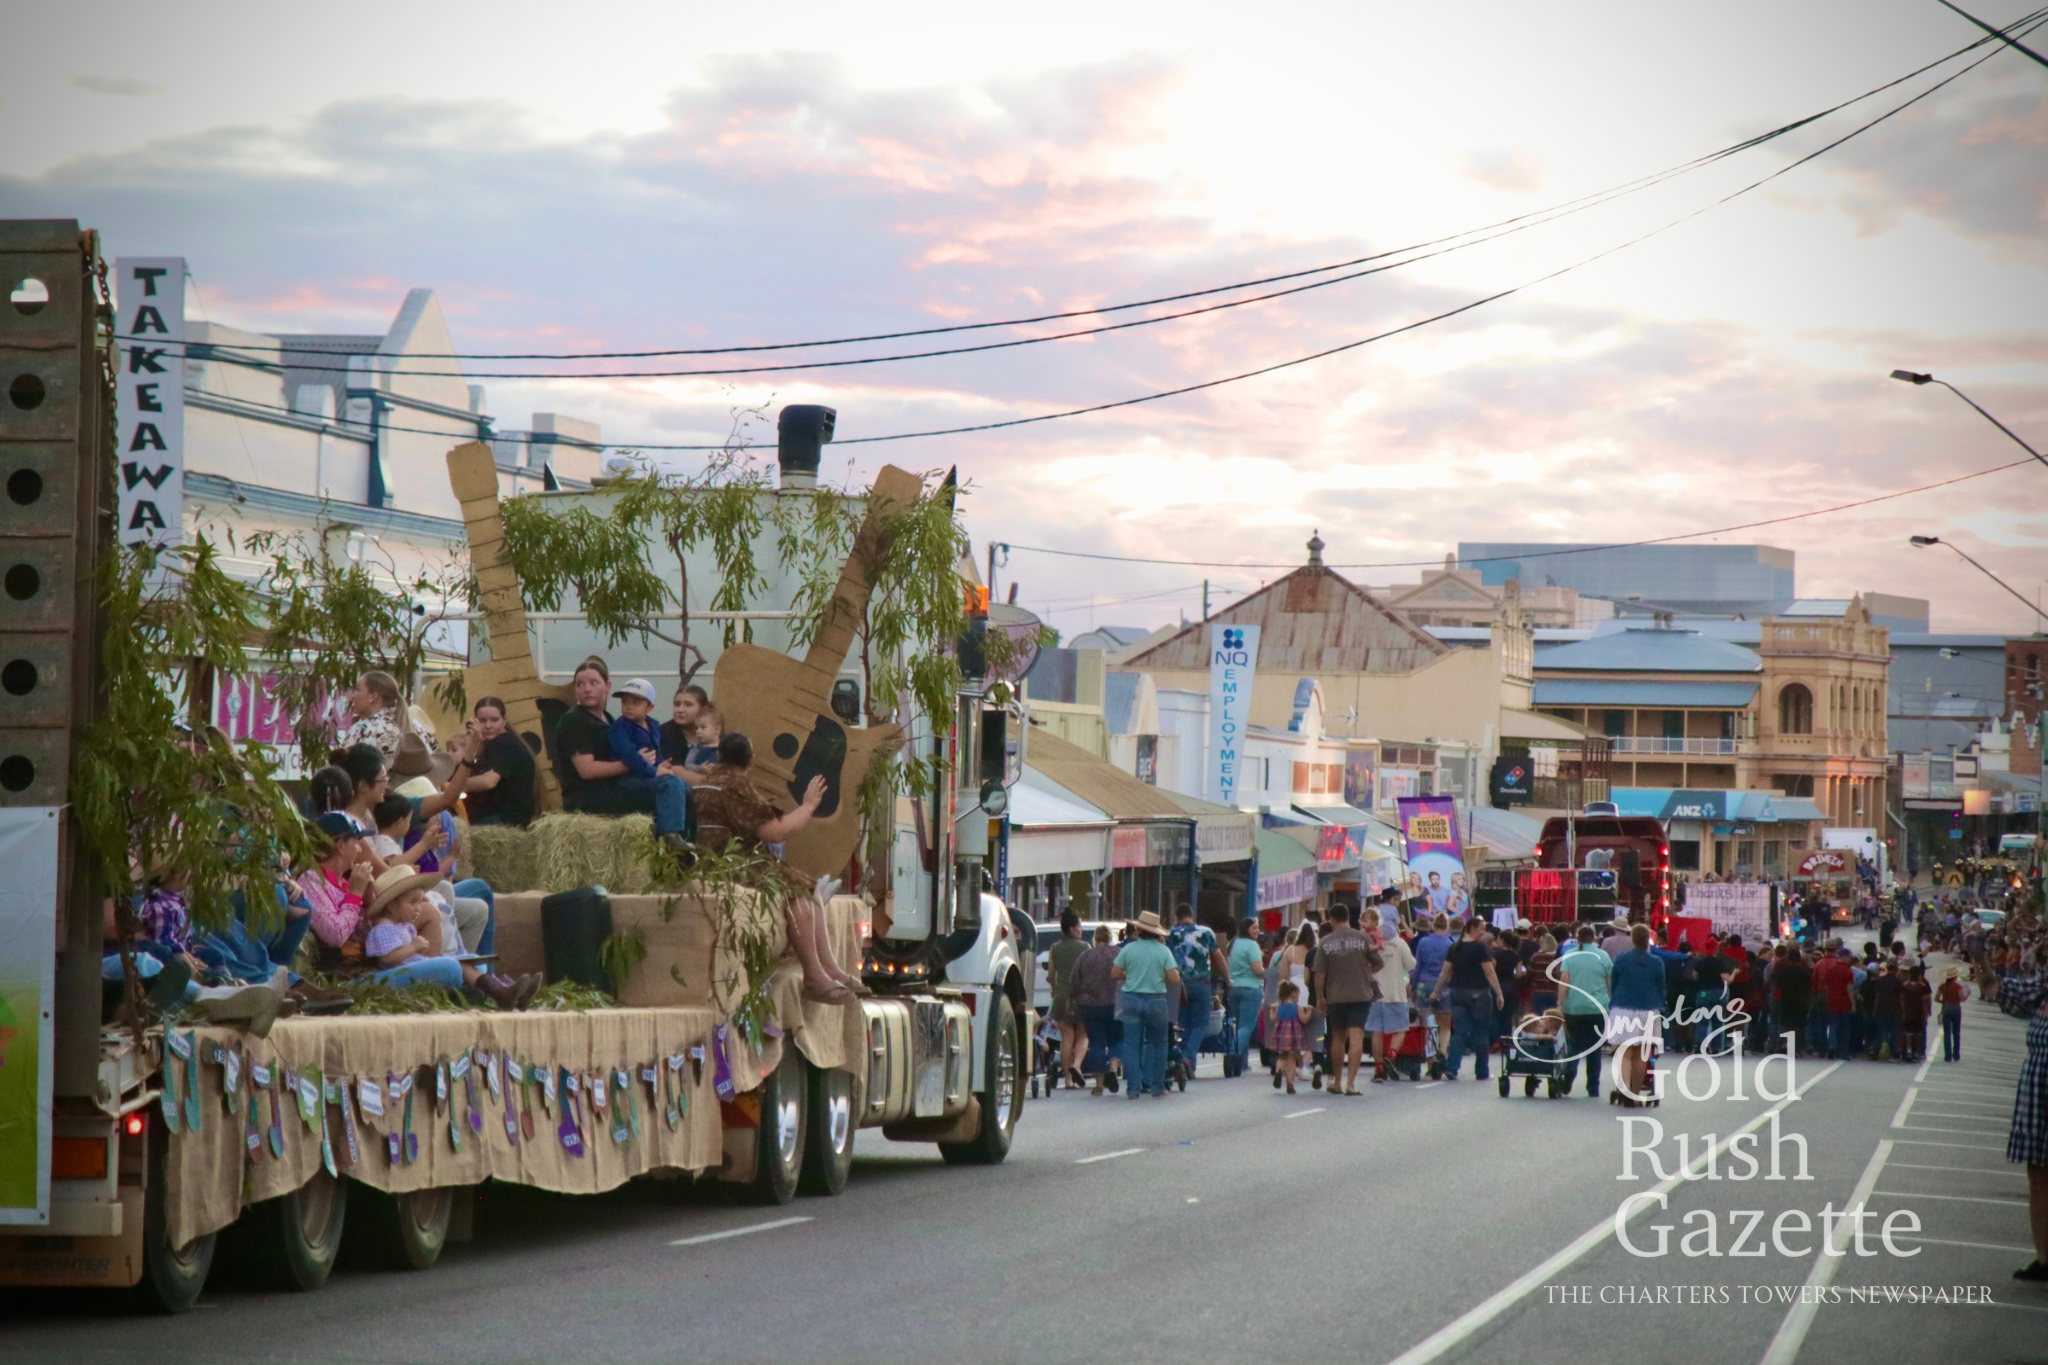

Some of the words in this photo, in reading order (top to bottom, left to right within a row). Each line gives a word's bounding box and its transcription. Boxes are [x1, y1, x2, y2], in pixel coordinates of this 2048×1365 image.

[1215, 651, 1248, 667] NQ
[1220, 668, 1237, 800] EMPLOYMENT
[1672, 805, 1701, 816] ANZ
